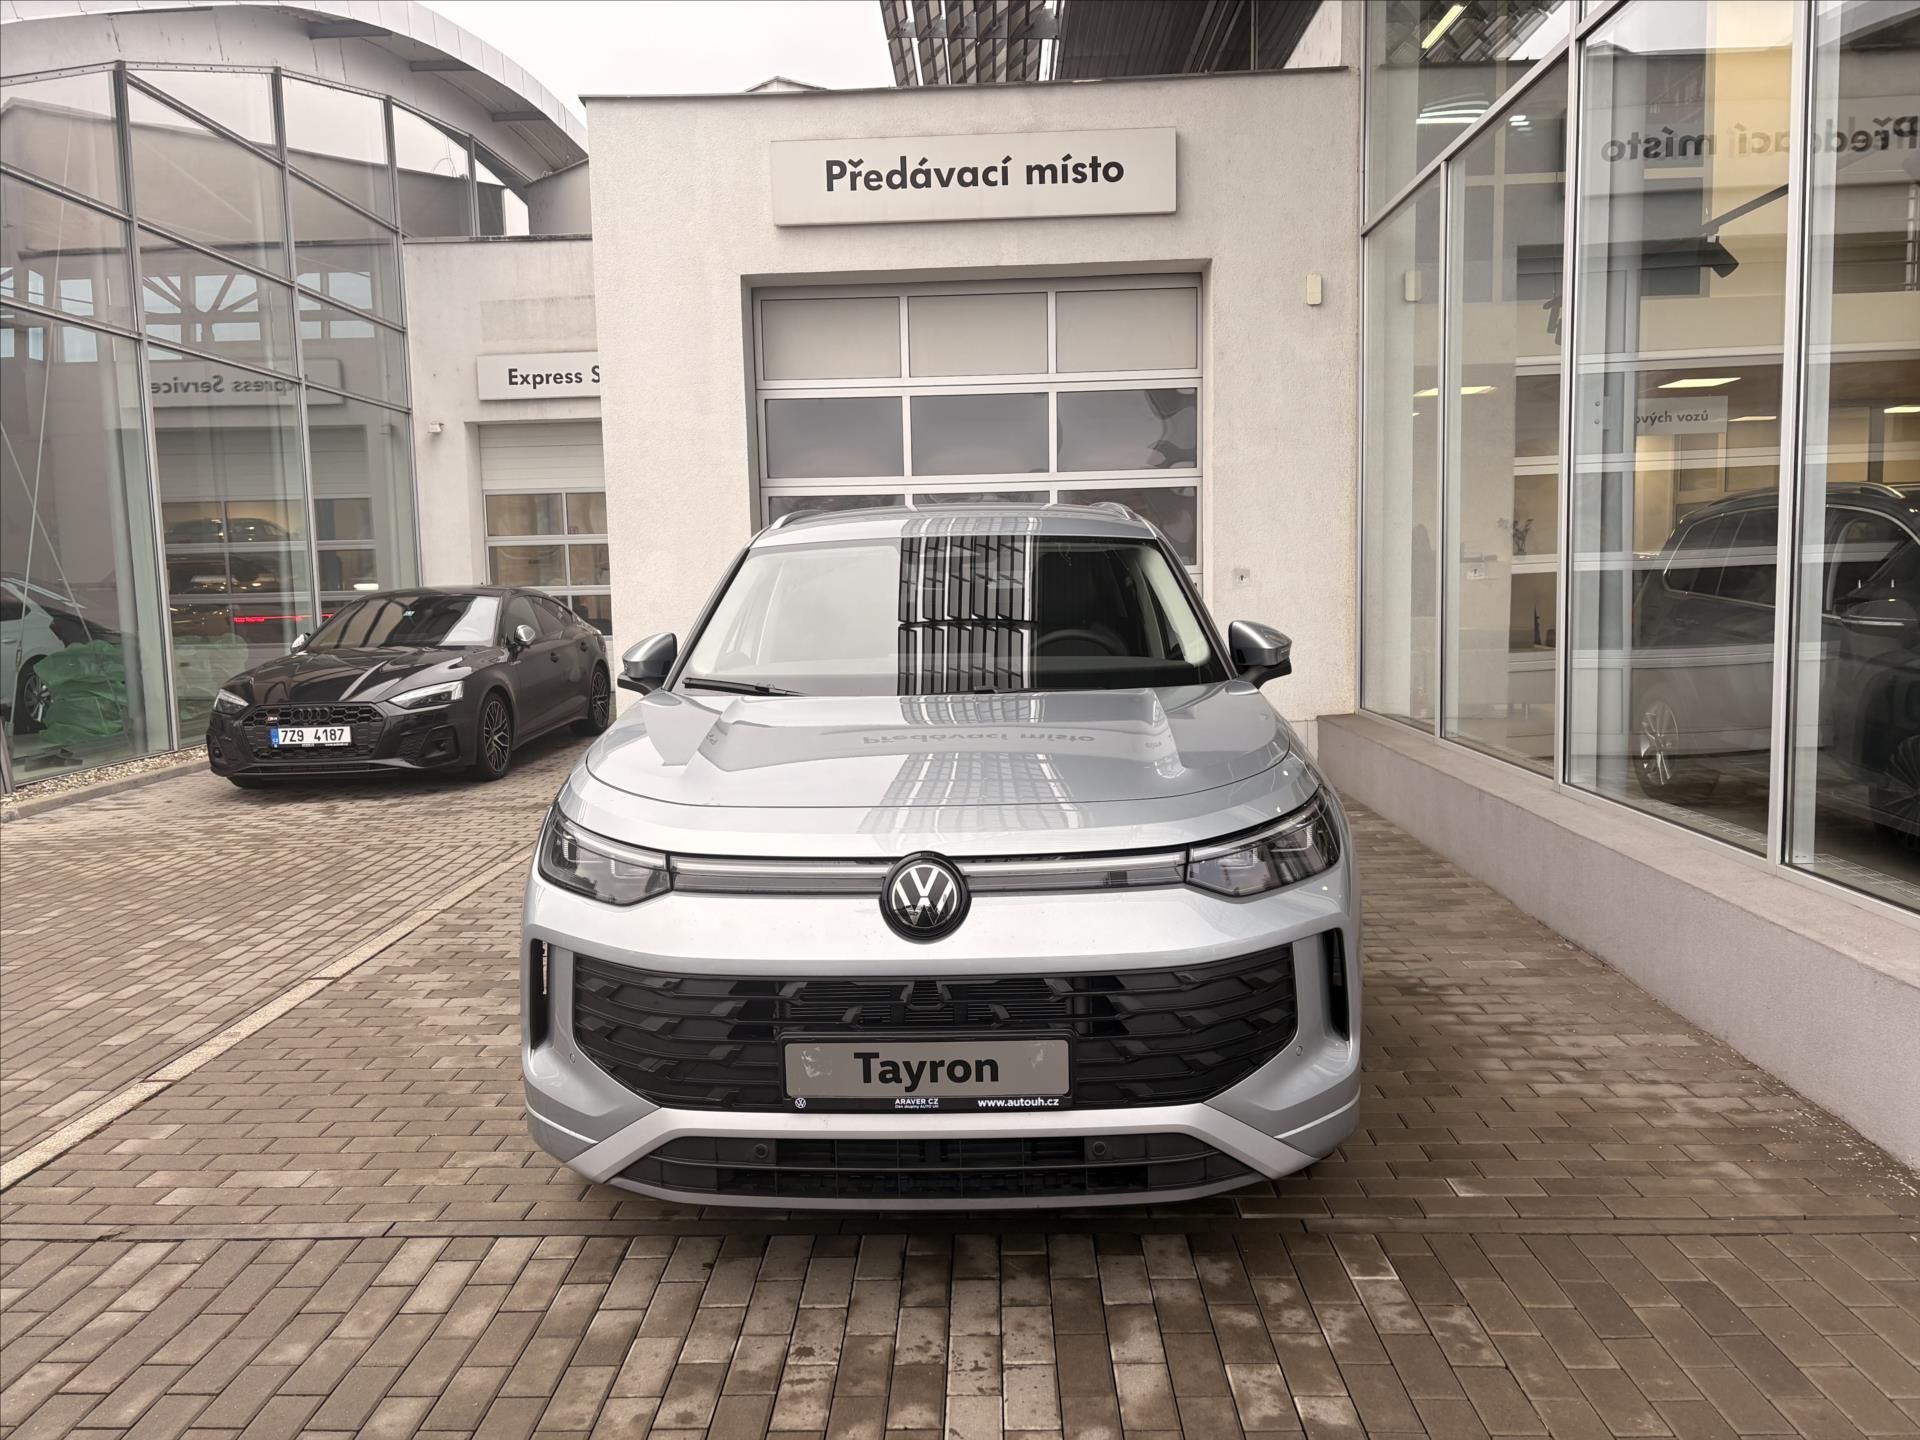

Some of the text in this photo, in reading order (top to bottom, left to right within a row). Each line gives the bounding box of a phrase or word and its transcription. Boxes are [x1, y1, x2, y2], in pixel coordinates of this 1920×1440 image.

[826, 153, 1125, 192] Předávací místo
[508, 368, 583, 390] Express
[281, 728, 345, 743] 7Z9 4187
[853, 1052, 999, 1093] Tayron
[977, 1097, 1060, 1108] www.autouh.cz
